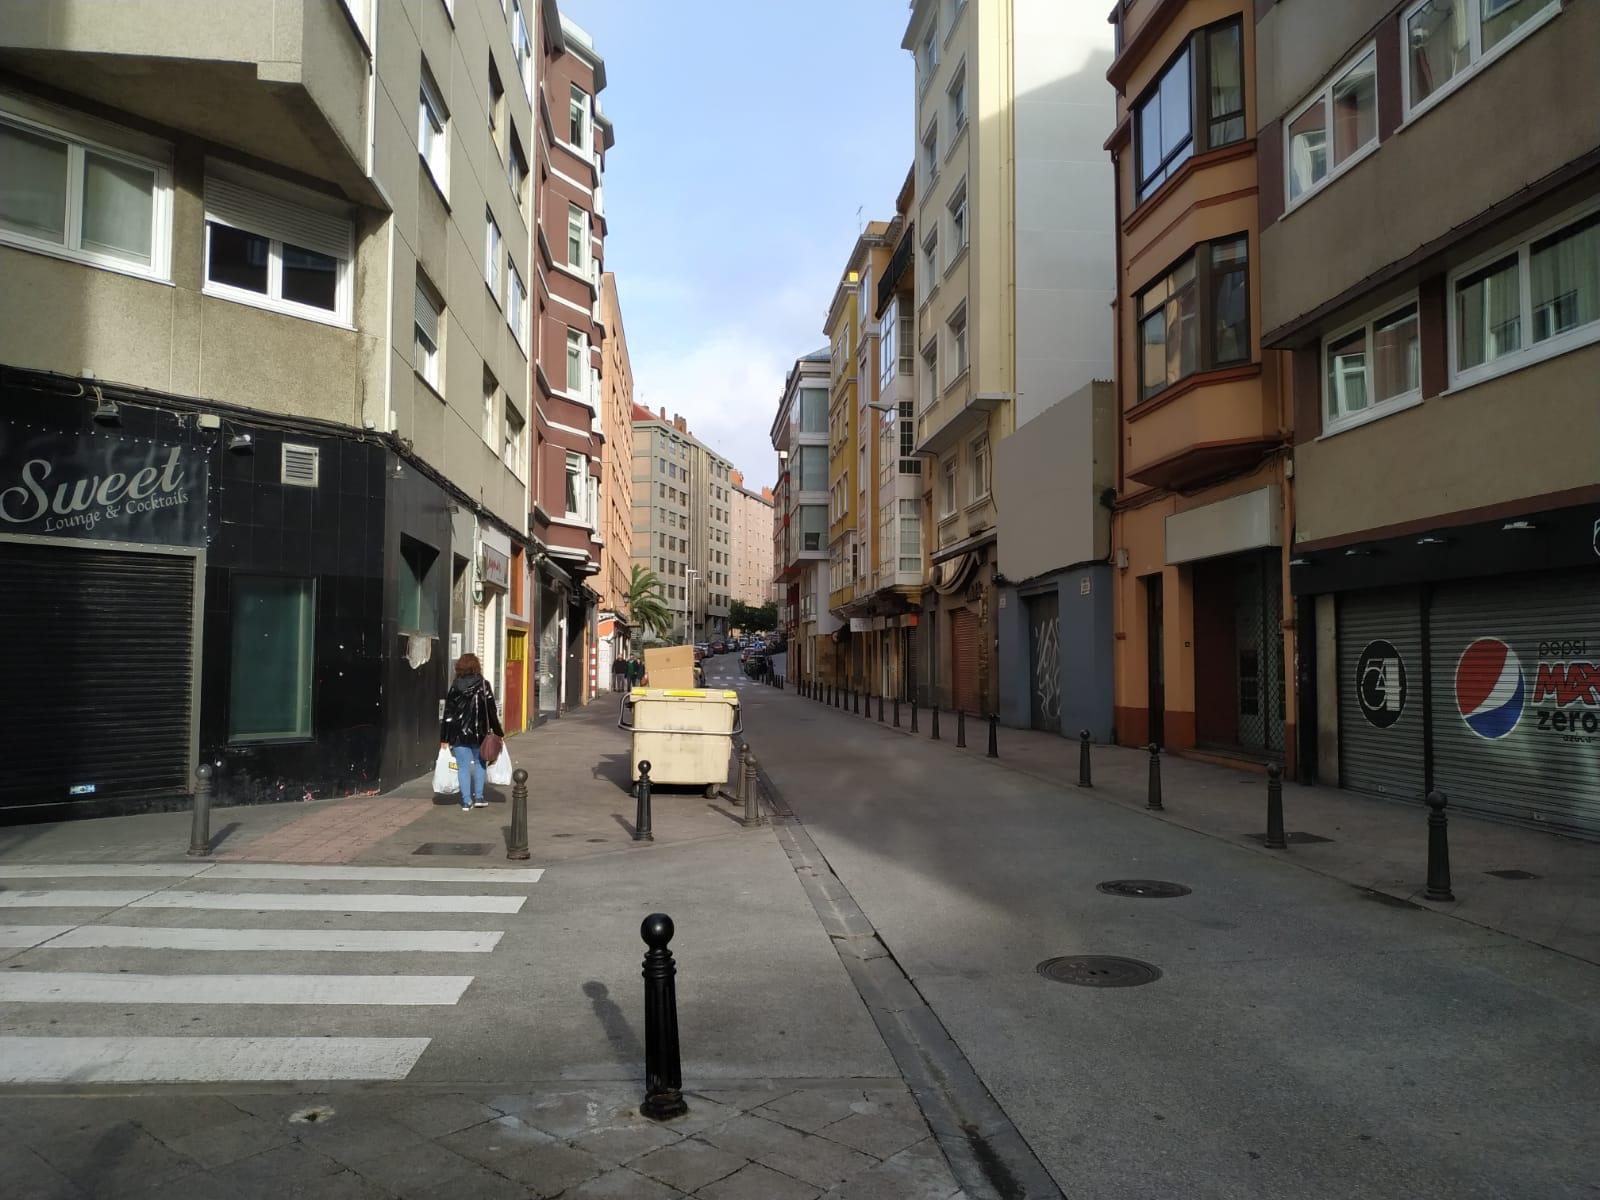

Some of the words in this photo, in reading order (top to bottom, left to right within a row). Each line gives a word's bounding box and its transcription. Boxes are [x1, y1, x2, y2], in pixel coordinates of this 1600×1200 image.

[0, 446, 185, 523] Sweet
[44, 511, 101, 532] Lounge
[105, 505, 121, 519] &
[125, 487, 189, 515] Cocktails
[1538, 640, 1586, 658] pepsi
[1537, 711, 1598, 733] zero
